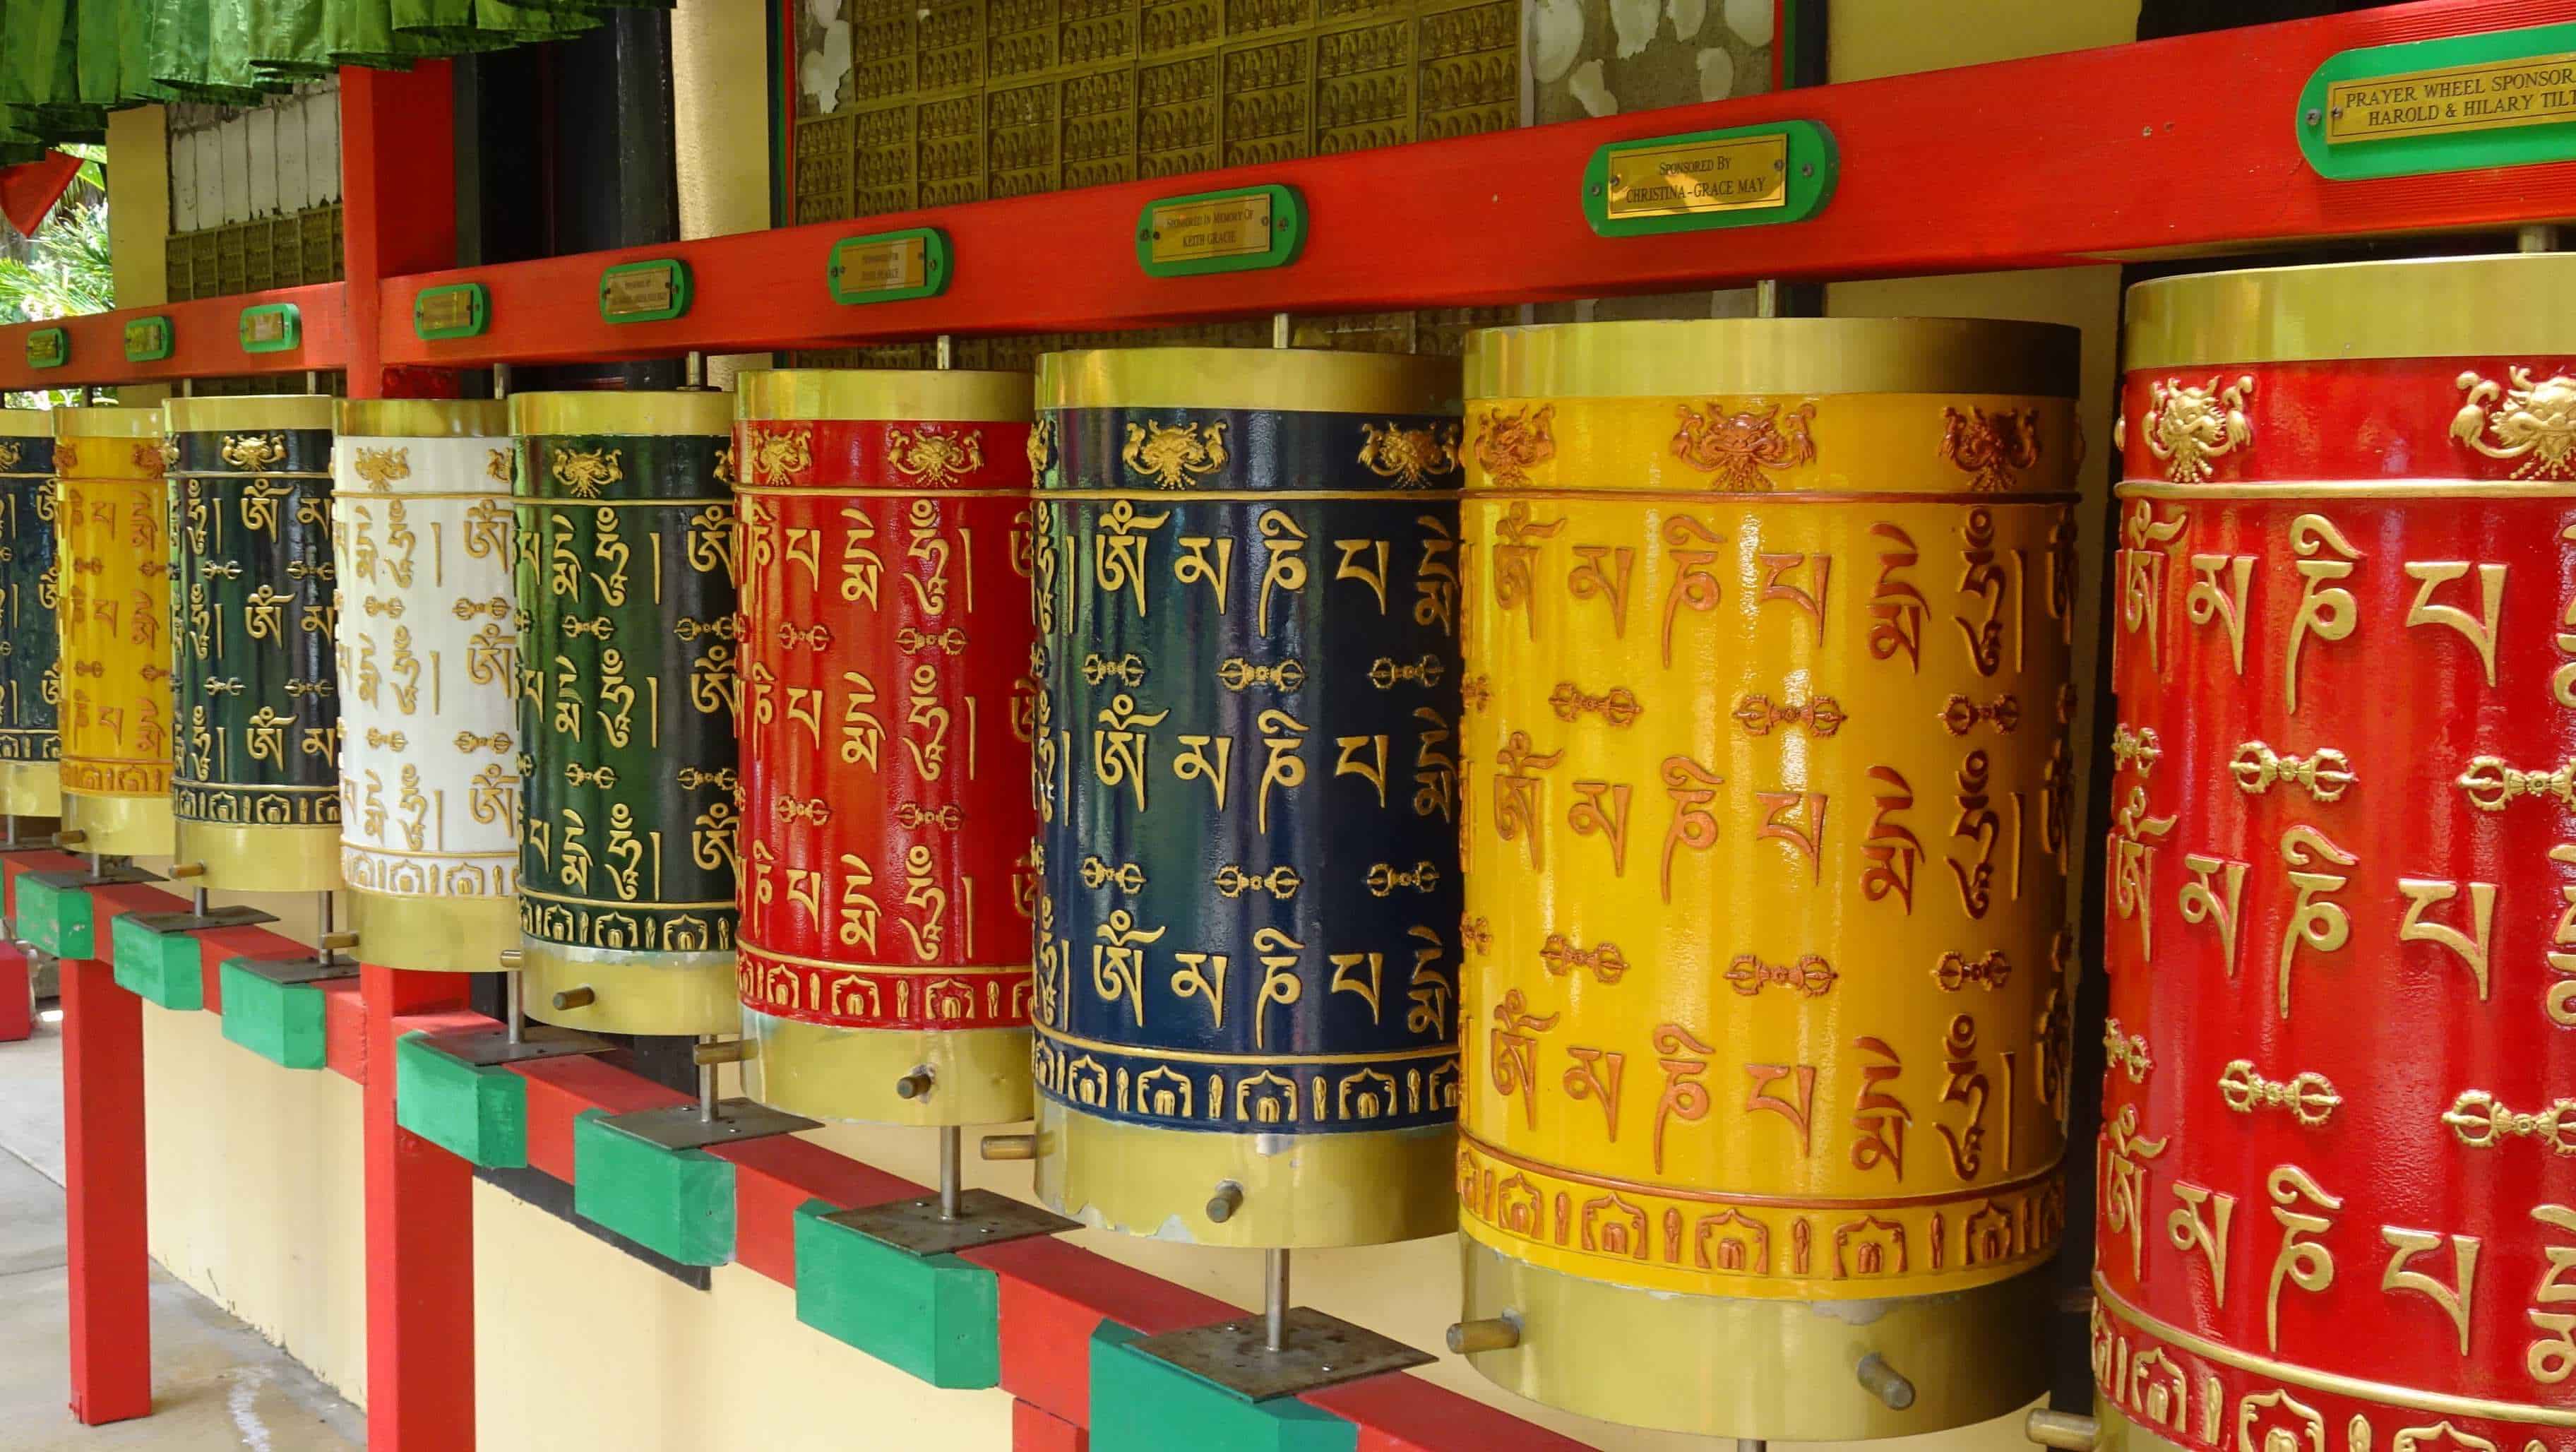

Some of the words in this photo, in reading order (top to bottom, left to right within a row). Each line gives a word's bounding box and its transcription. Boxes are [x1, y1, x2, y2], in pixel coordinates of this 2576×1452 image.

[2345, 87, 2417, 108] PRAYER
[2423, 78, 2486, 99] WHEEL
[2368, 104, 2440, 126] HAROLD
[2445, 103, 2458, 118] &
[2463, 95, 2534, 117] HILARY
[1738, 177, 1765, 193] MAY
